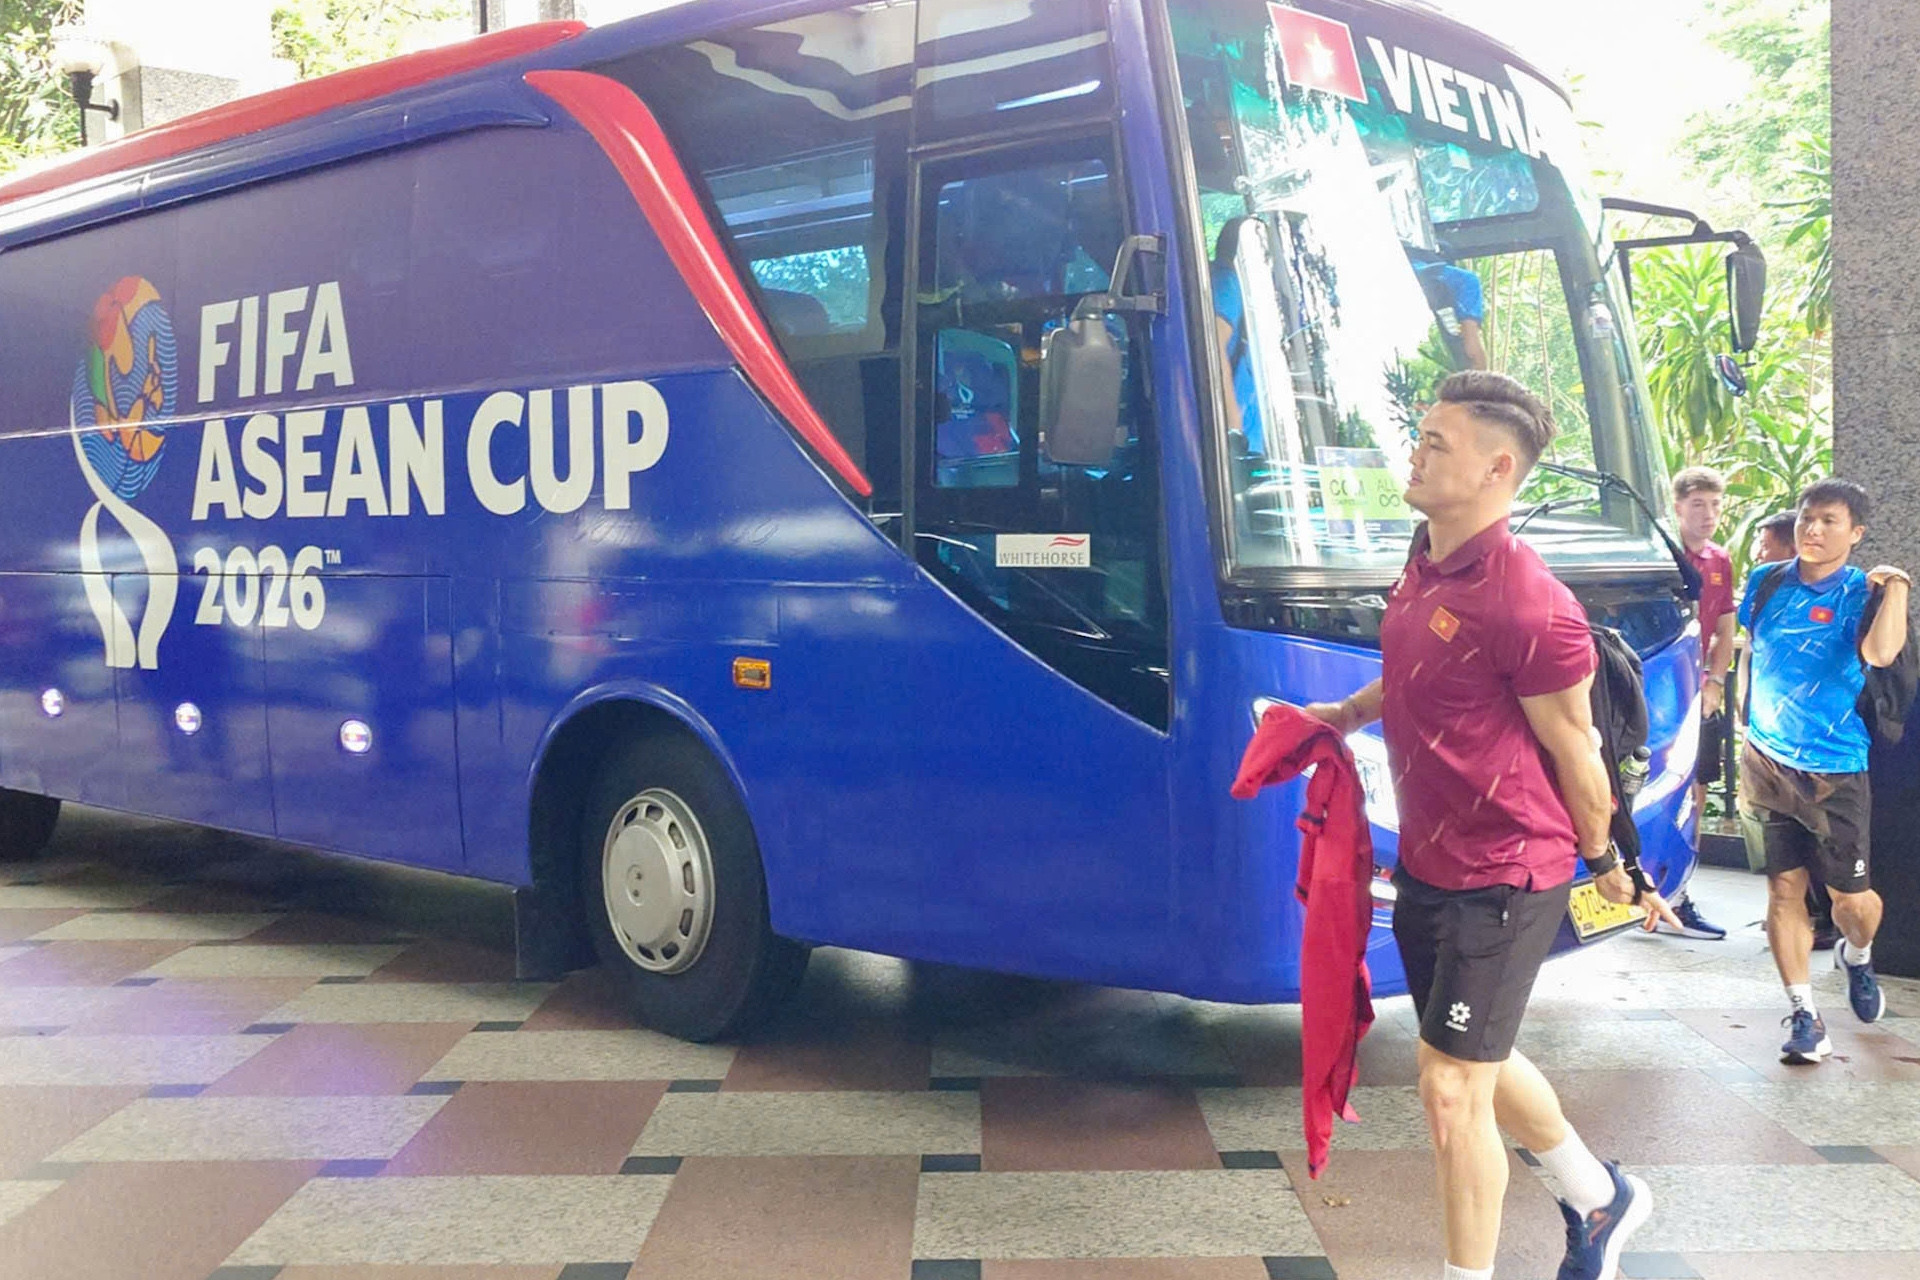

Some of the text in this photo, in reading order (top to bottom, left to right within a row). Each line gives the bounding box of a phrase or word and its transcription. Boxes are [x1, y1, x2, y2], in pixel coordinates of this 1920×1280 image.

[1366, 36, 1560, 162] VIETNA
[197, 281, 355, 403] FIFA
[191, 380, 670, 521] ASEAN CUP
[1000, 551, 1085, 565] WHITEHORSE
